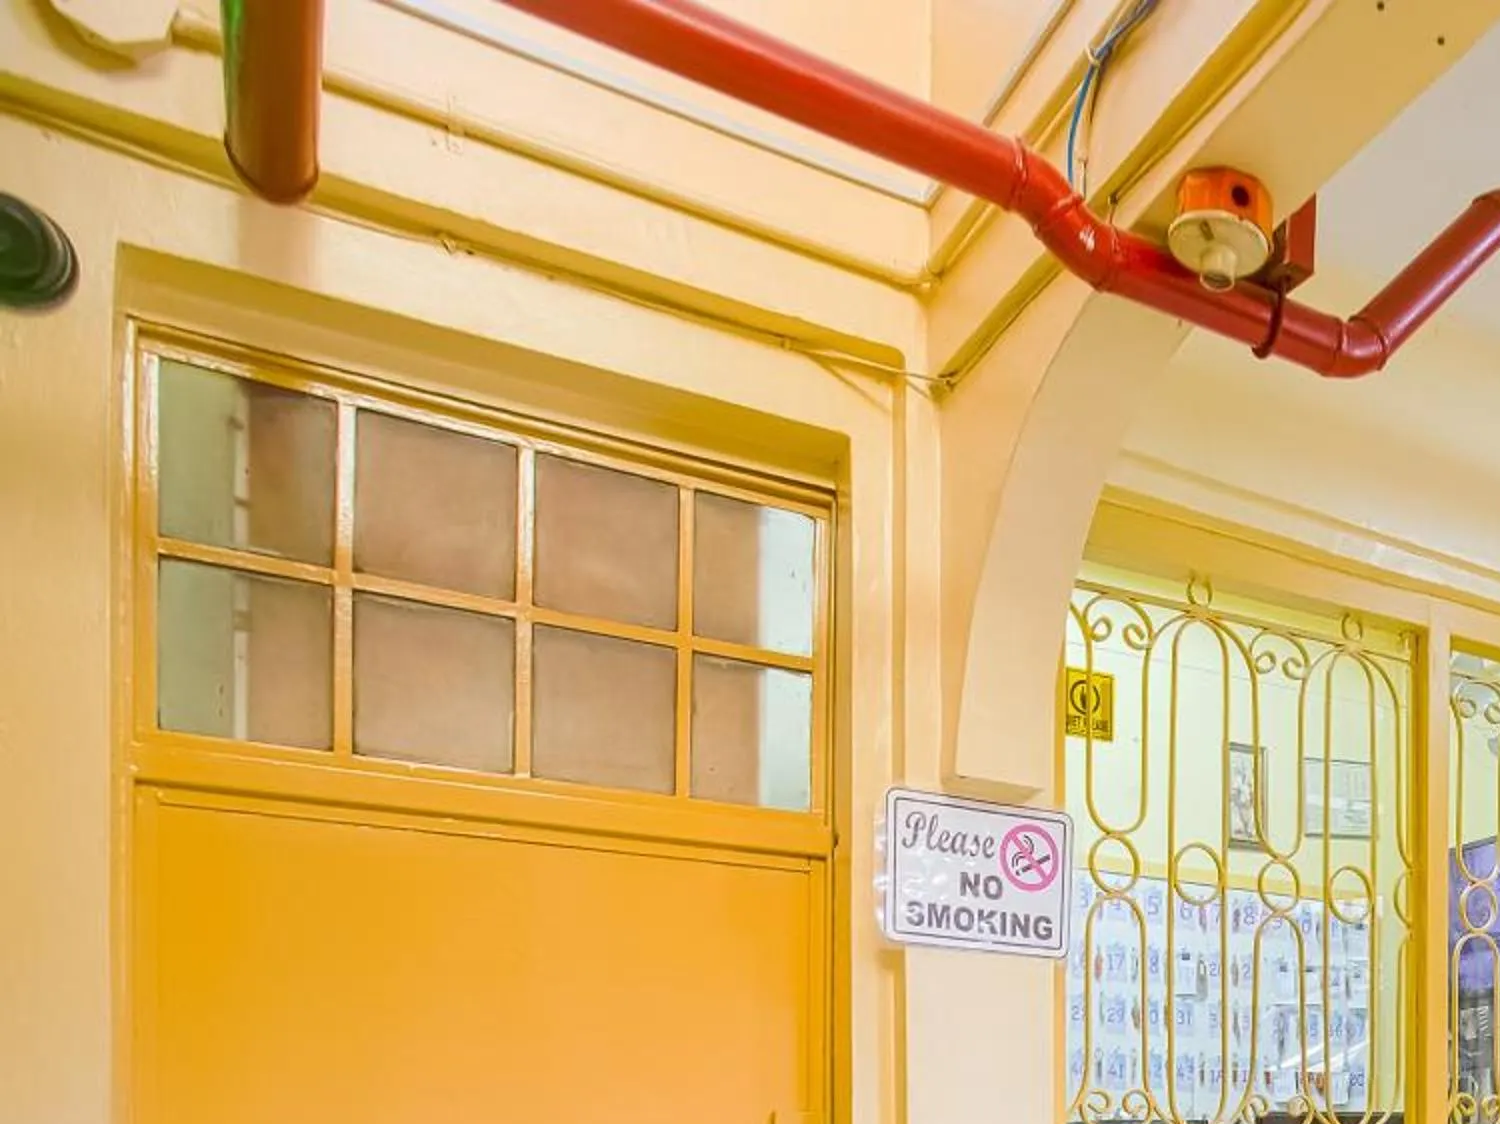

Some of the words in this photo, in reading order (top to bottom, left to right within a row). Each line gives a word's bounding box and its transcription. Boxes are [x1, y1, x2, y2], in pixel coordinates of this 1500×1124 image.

[902, 811, 995, 859] Please
[960, 871, 1003, 900] NO
[906, 901, 1053, 940] SMOKING
[1147, 896, 1159, 915] 5
[1243, 905, 1255, 926] 8
[1107, 953, 1125, 972] 17
